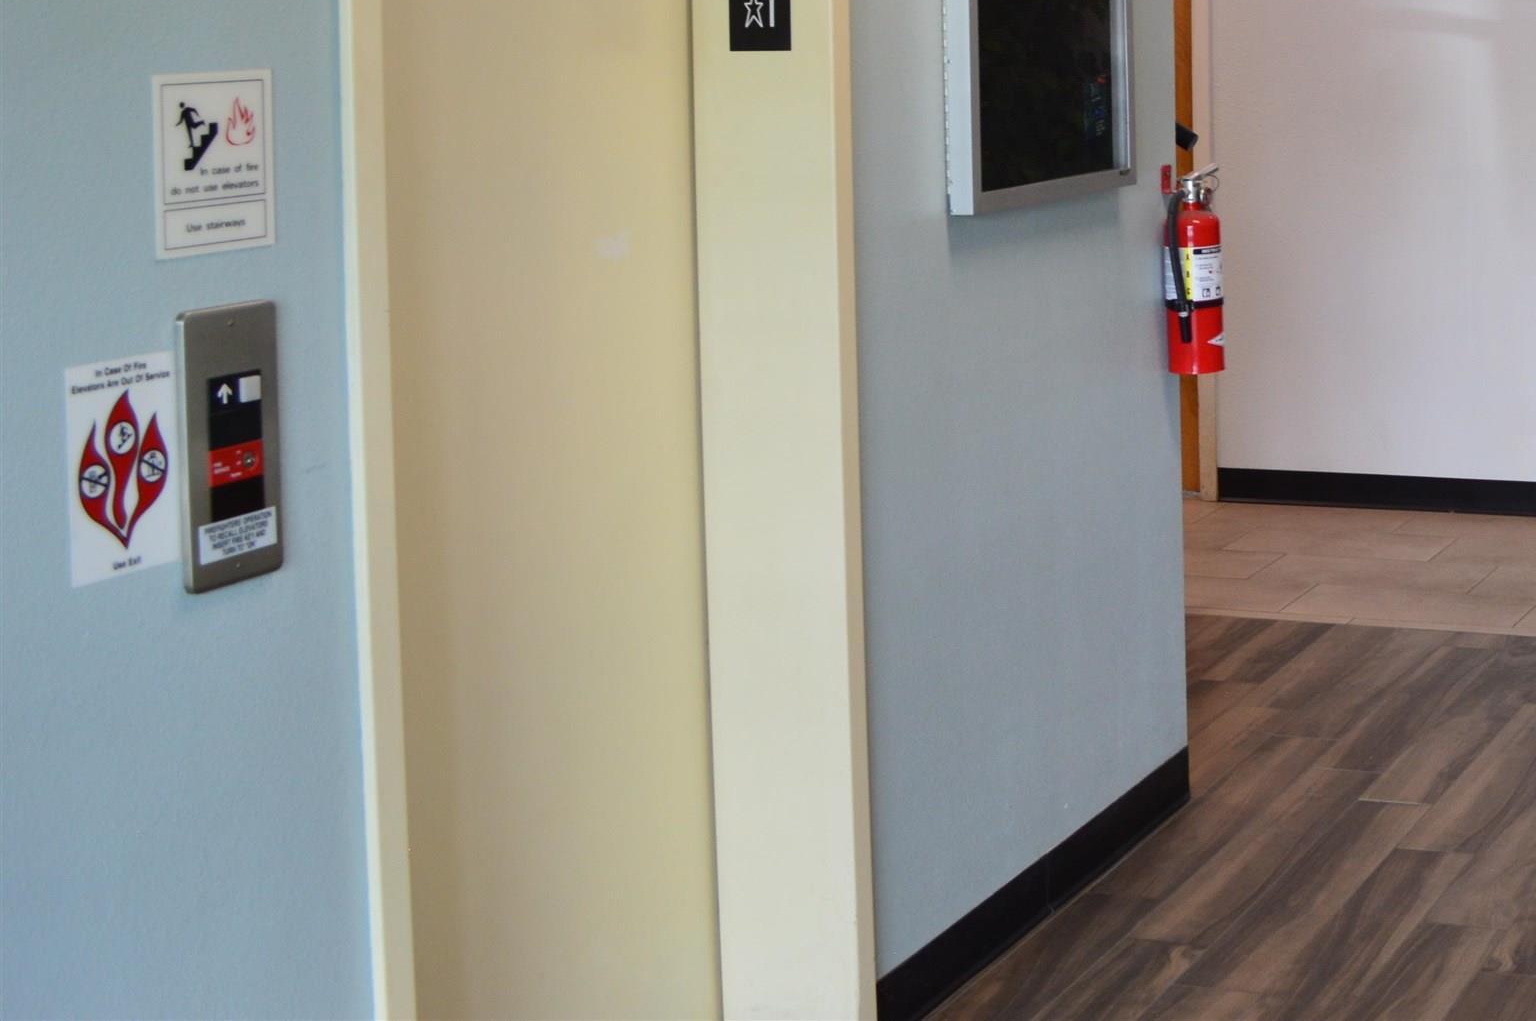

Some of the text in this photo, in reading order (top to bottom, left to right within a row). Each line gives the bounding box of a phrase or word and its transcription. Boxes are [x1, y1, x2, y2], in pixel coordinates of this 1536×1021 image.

[199, 162, 259, 176] In case of fire
[170, 180, 260, 196] do not use elevators
[186, 219, 246, 233] Use stairways
[95, 361, 147, 378] In Case Of Fire
[71, 370, 170, 395] Elevators Are Out Of Service
[243, 511, 272, 524] OPERATION
[217, 530, 238, 540] RECALL
[238, 520, 268, 533] ELEVATORS
[212, 538, 231, 549] INSERT
[113, 555, 142, 571] Use Exit
